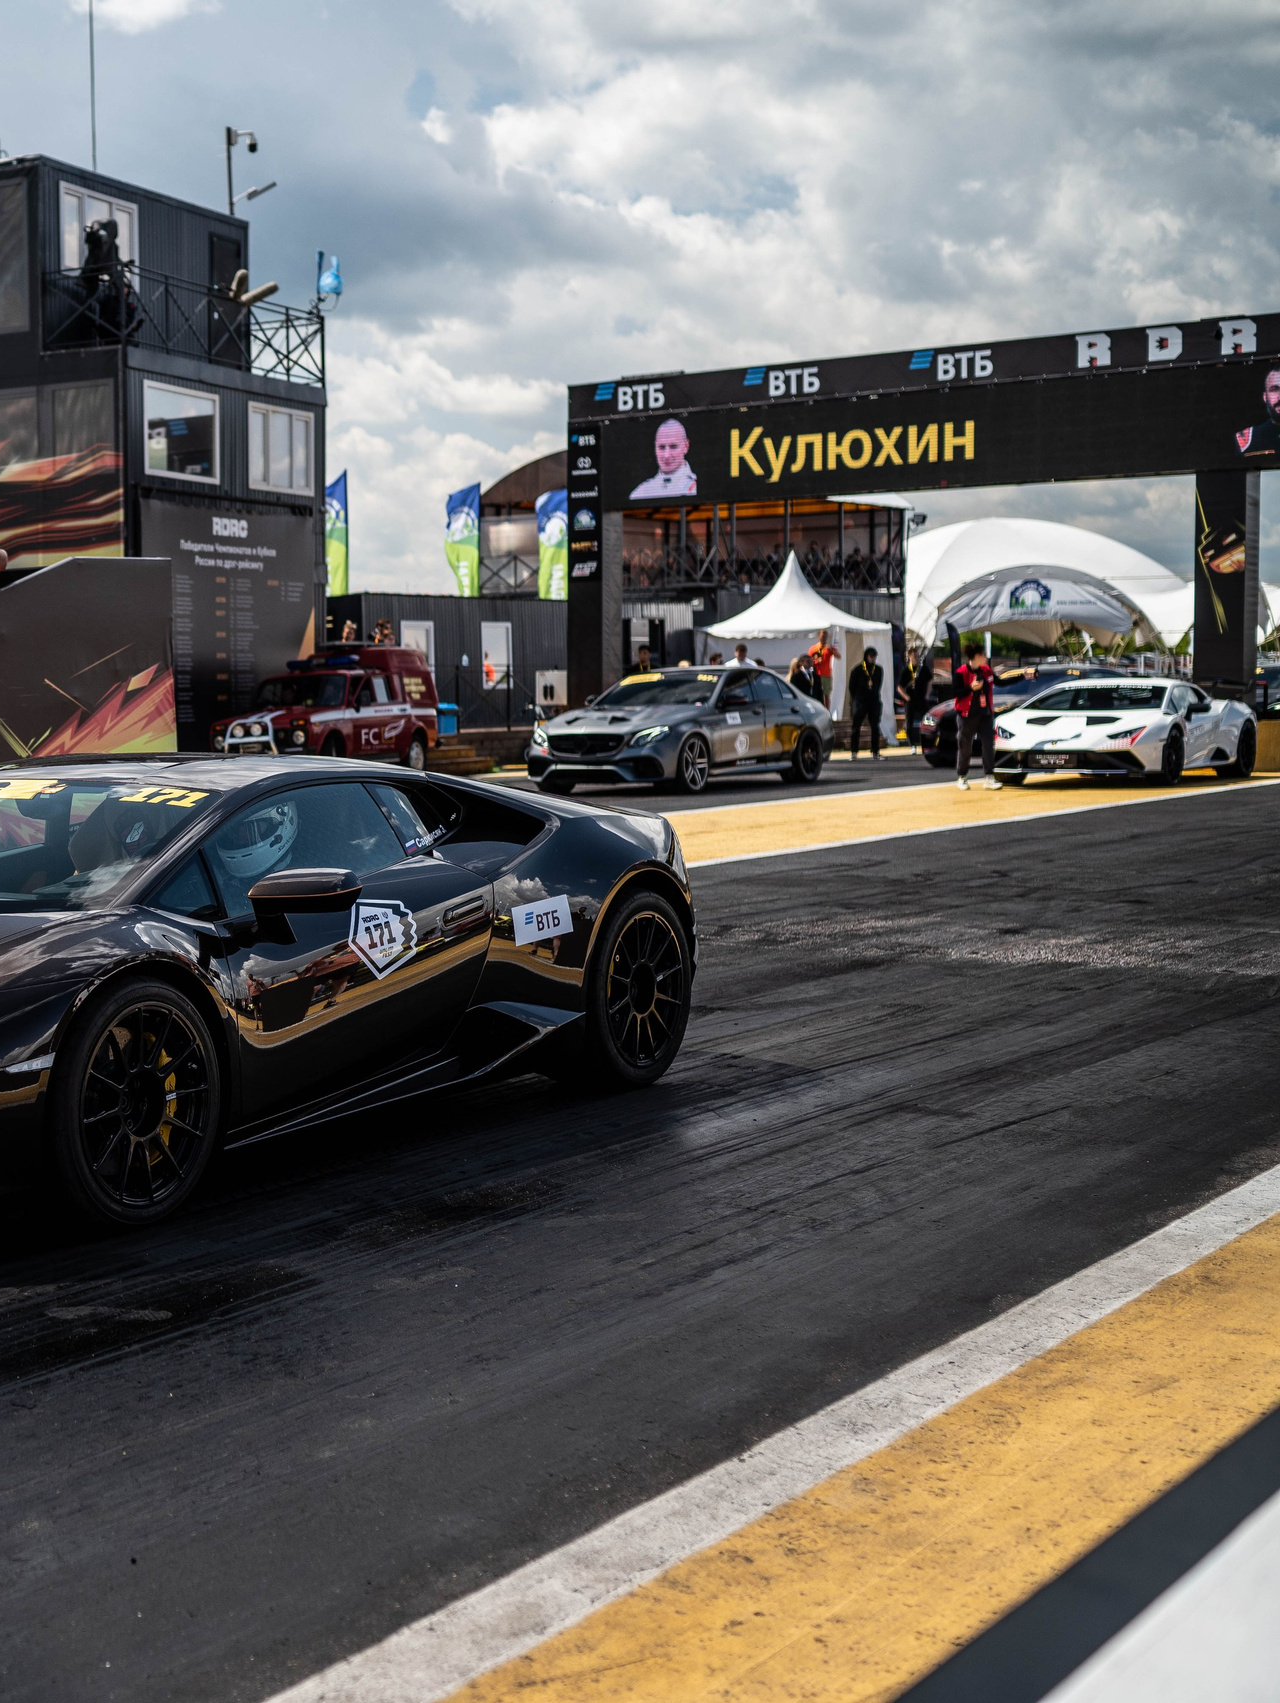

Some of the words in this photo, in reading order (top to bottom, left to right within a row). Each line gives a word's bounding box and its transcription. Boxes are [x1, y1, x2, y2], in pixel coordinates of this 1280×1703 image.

[936, 349, 994, 381] ВТБ
[768, 366, 820, 397] ВТБ
[617, 382, 666, 412] ВТБ
[577, 434, 596, 447] ВТБ
[730, 420, 975, 483] Кулюхин
[212, 516, 248, 538] RDRC
[361, 727, 380, 745] FC
[118, 786, 211, 808] 171
[361, 913, 380, 924] RDRC
[535, 909, 561, 932] ВТБ
[364, 920, 397, 950] 171
